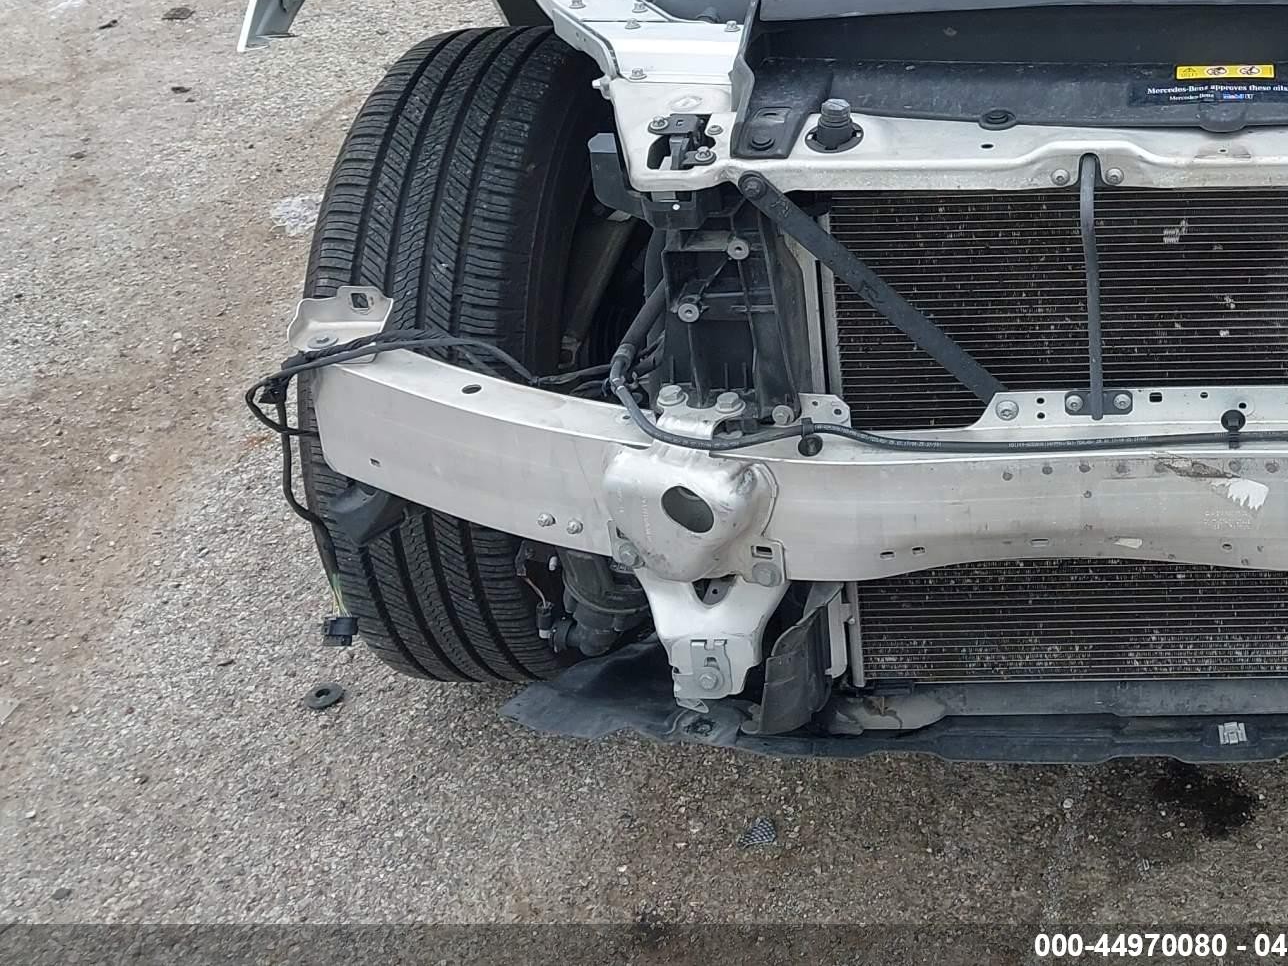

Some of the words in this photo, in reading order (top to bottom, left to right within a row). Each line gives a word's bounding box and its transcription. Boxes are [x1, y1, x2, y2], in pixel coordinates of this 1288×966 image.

[1147, 84, 1209, 95] Mercedes-Benz
[1210, 84, 1248, 92] approves
[1249, 84, 1272, 92] these
